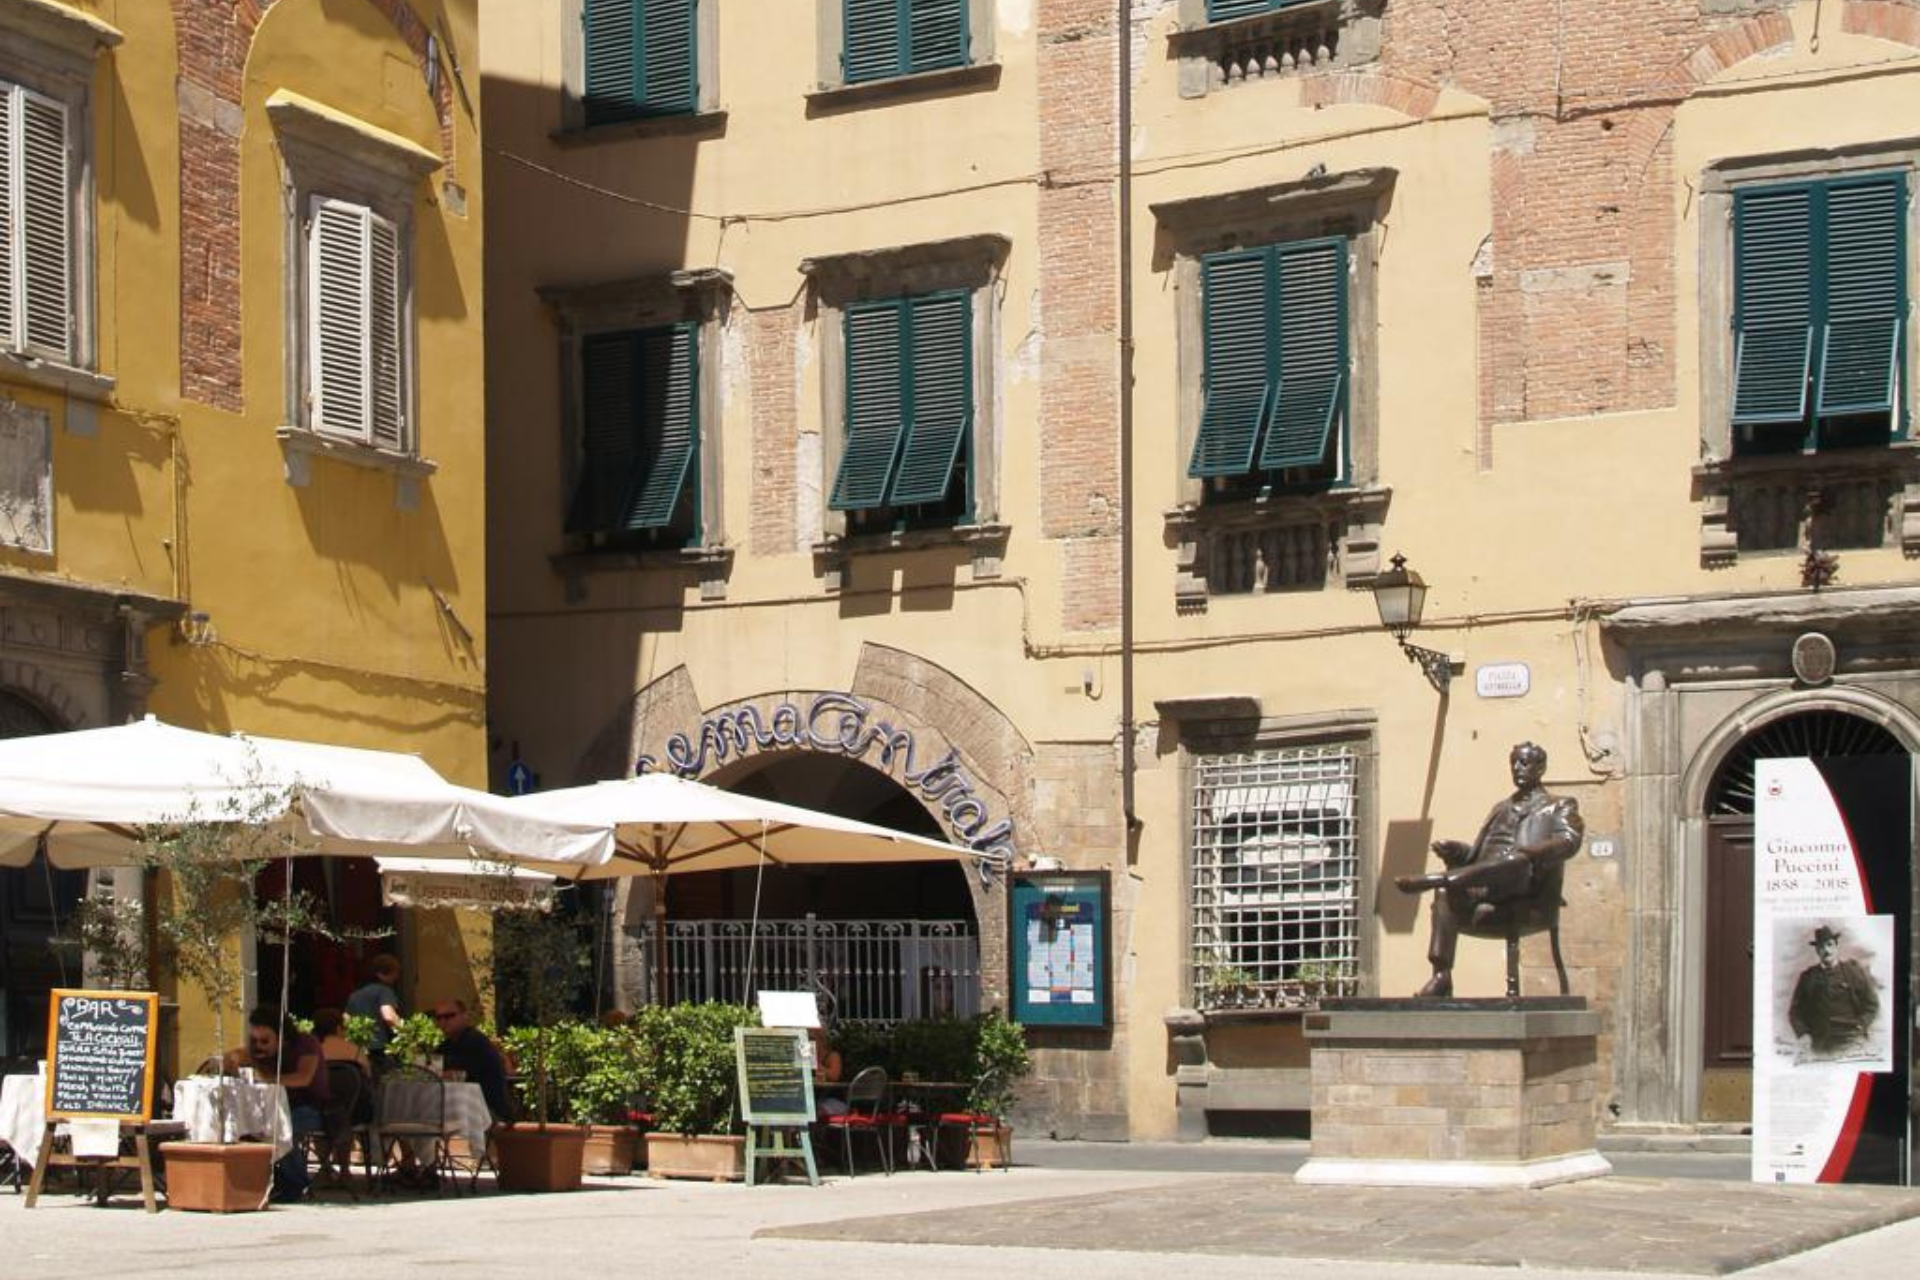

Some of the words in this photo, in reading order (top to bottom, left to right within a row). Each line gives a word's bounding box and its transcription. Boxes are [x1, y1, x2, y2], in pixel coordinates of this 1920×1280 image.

[1767, 838, 1847, 854] Giacomo
[1774, 857, 1839, 873] Puccini
[1767, 879, 1798, 891] 1858
[71, 998, 119, 1019] BAR
